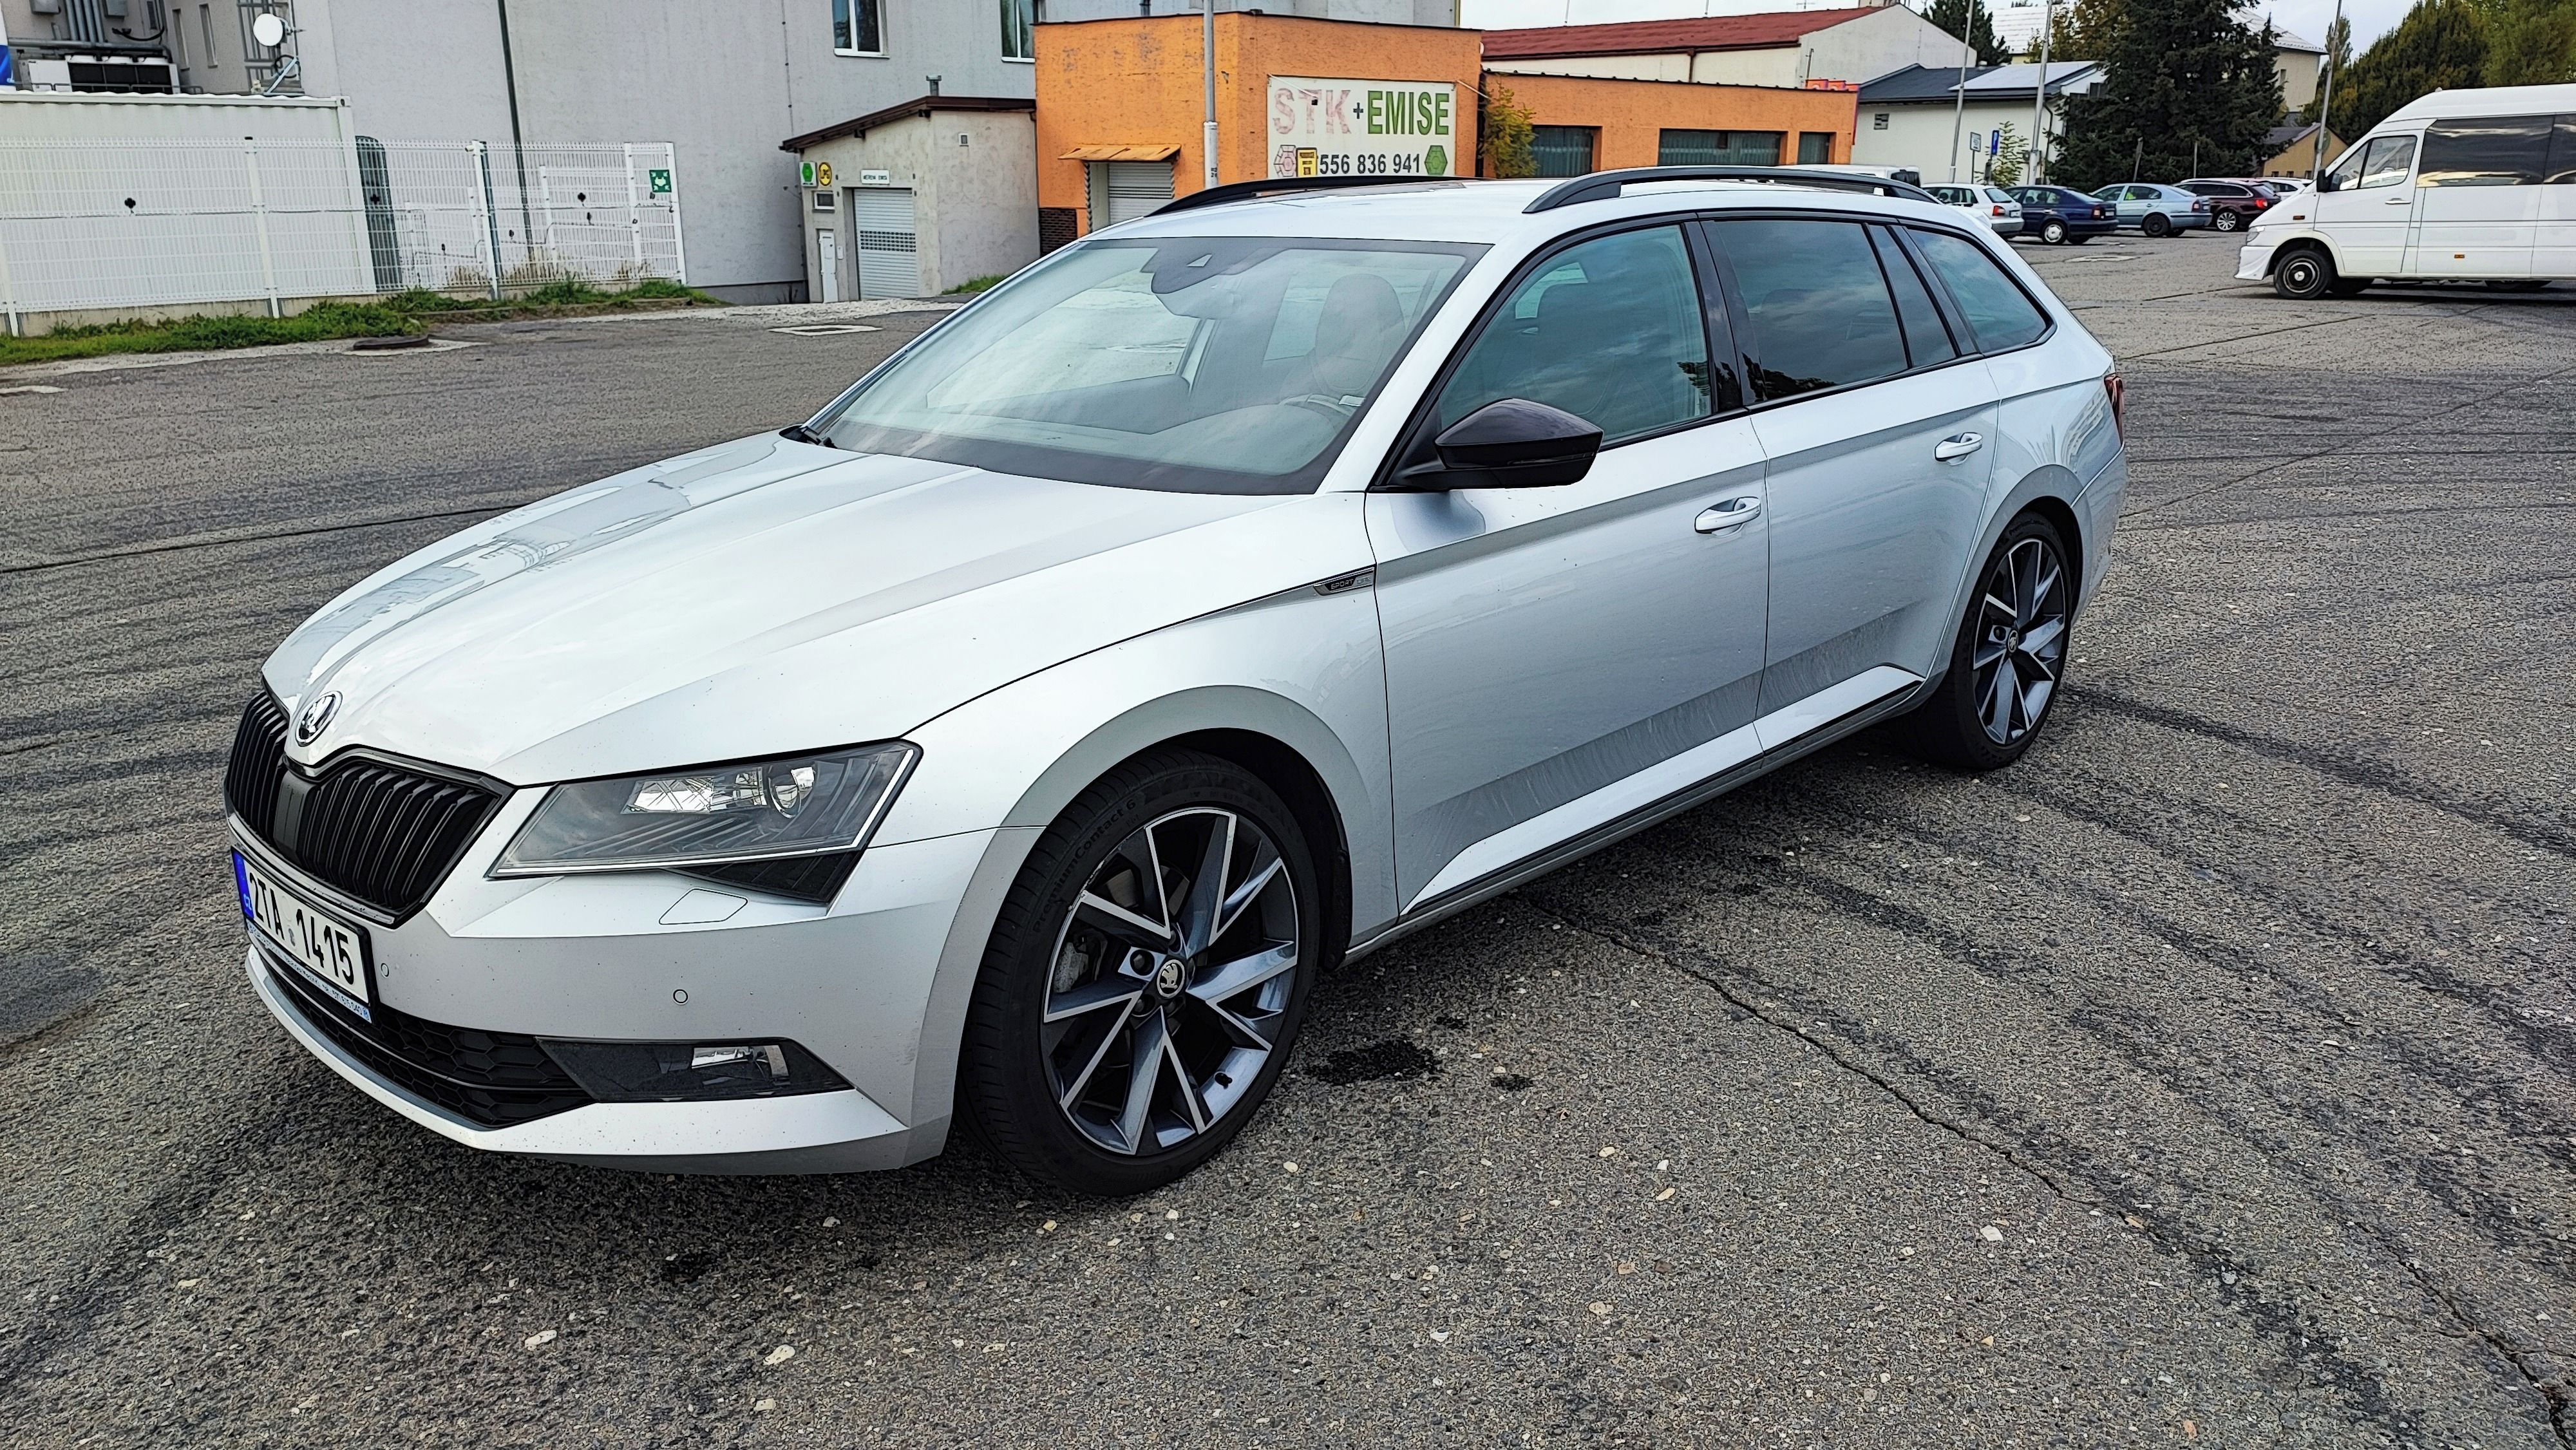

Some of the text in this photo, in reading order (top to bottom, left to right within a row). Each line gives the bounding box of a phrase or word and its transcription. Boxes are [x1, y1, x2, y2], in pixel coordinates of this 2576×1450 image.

[1273, 88, 1352, 135] STK
[1367, 90, 1450, 135] EMISE
[1319, 154, 1350, 174] 556
[1357, 154, 1387, 174] 836
[1392, 153, 1419, 174] 941
[1331, 579, 1354, 590] SPORT
[249, 872, 285, 941] 2TA
[296, 909, 354, 985] 1415
